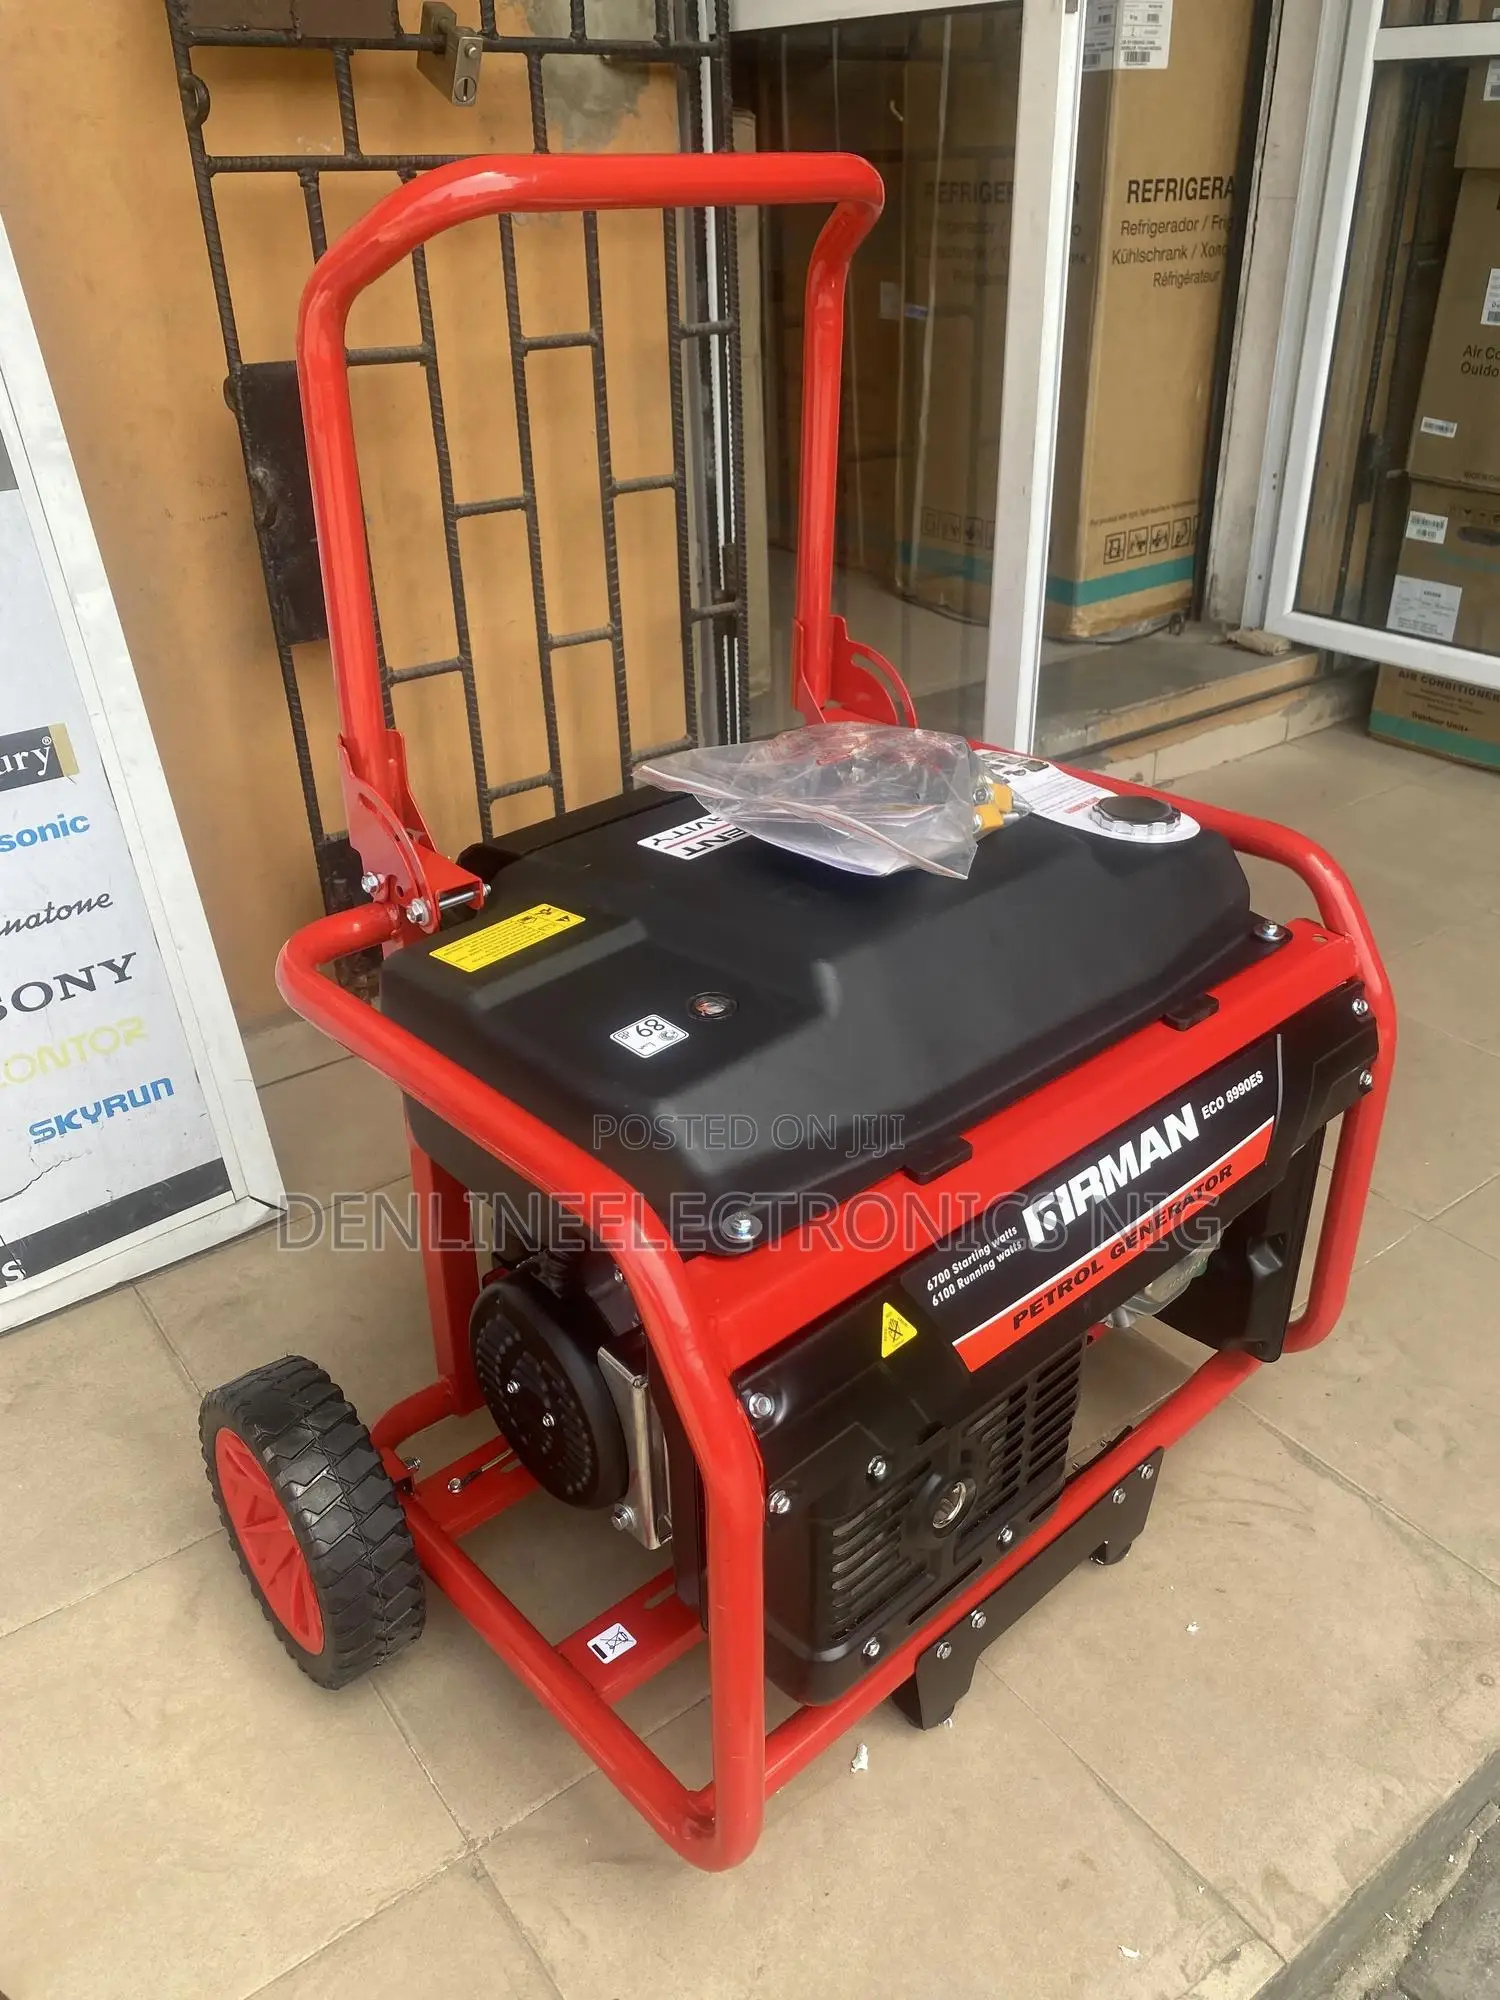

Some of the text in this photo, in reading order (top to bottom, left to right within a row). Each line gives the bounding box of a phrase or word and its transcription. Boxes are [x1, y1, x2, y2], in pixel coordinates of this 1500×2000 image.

[1112, 245, 1188, 266] Kühlschrank
[1120, 216, 1199, 239] Refrigerador
[1153, 270, 1220, 289] Réfrigérateur
[1463, 344, 1483, 358] Air
[0, 813, 90, 853] sonic
[0, 951, 137, 1020] ONY
[0, 1016, 147, 1088] ONTOR
[29, 1077, 174, 1144] SKYRUN
[1021, 1070, 1264, 1248] FIRMAN ECO 8990ES
[926, 1226, 1018, 1291] 6700 Starting watts
[932, 1240, 1022, 1307] 6100 Running watts
[1012, 1258, 1104, 1330] PETROL
[1109, 1164, 1233, 1260] GENERATOR
